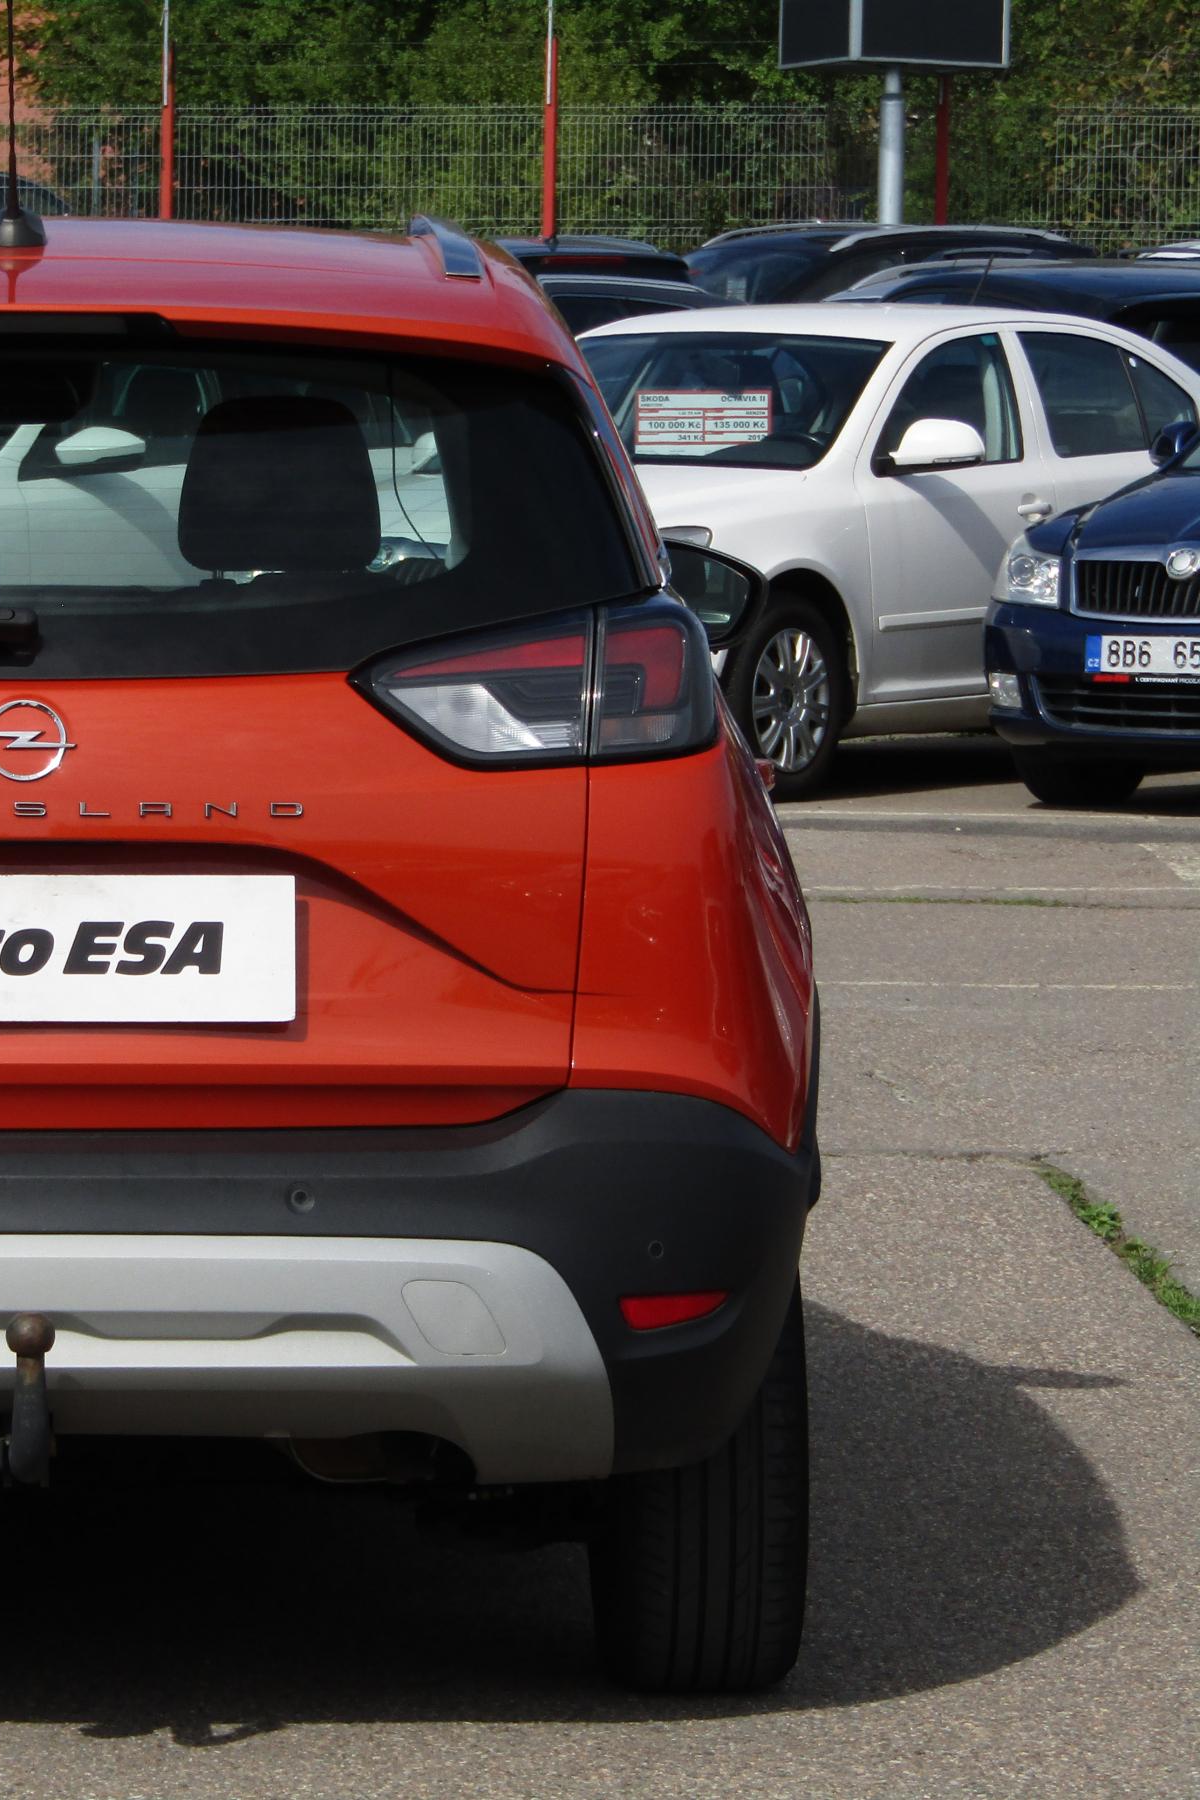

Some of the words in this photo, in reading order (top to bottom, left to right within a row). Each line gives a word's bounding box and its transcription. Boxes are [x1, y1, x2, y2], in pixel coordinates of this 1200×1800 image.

[648, 421, 665, 429] 100
[668, 421, 685, 429] 000
[689, 421, 701, 429] Kč
[714, 421, 731, 429] 135
[733, 421, 750, 429] 000
[753, 421, 765, 429] Kč
[1107, 640, 1152, 667] 8B6
[1087, 658, 1100, 667] CZ
[63, 920, 224, 976] ESA
